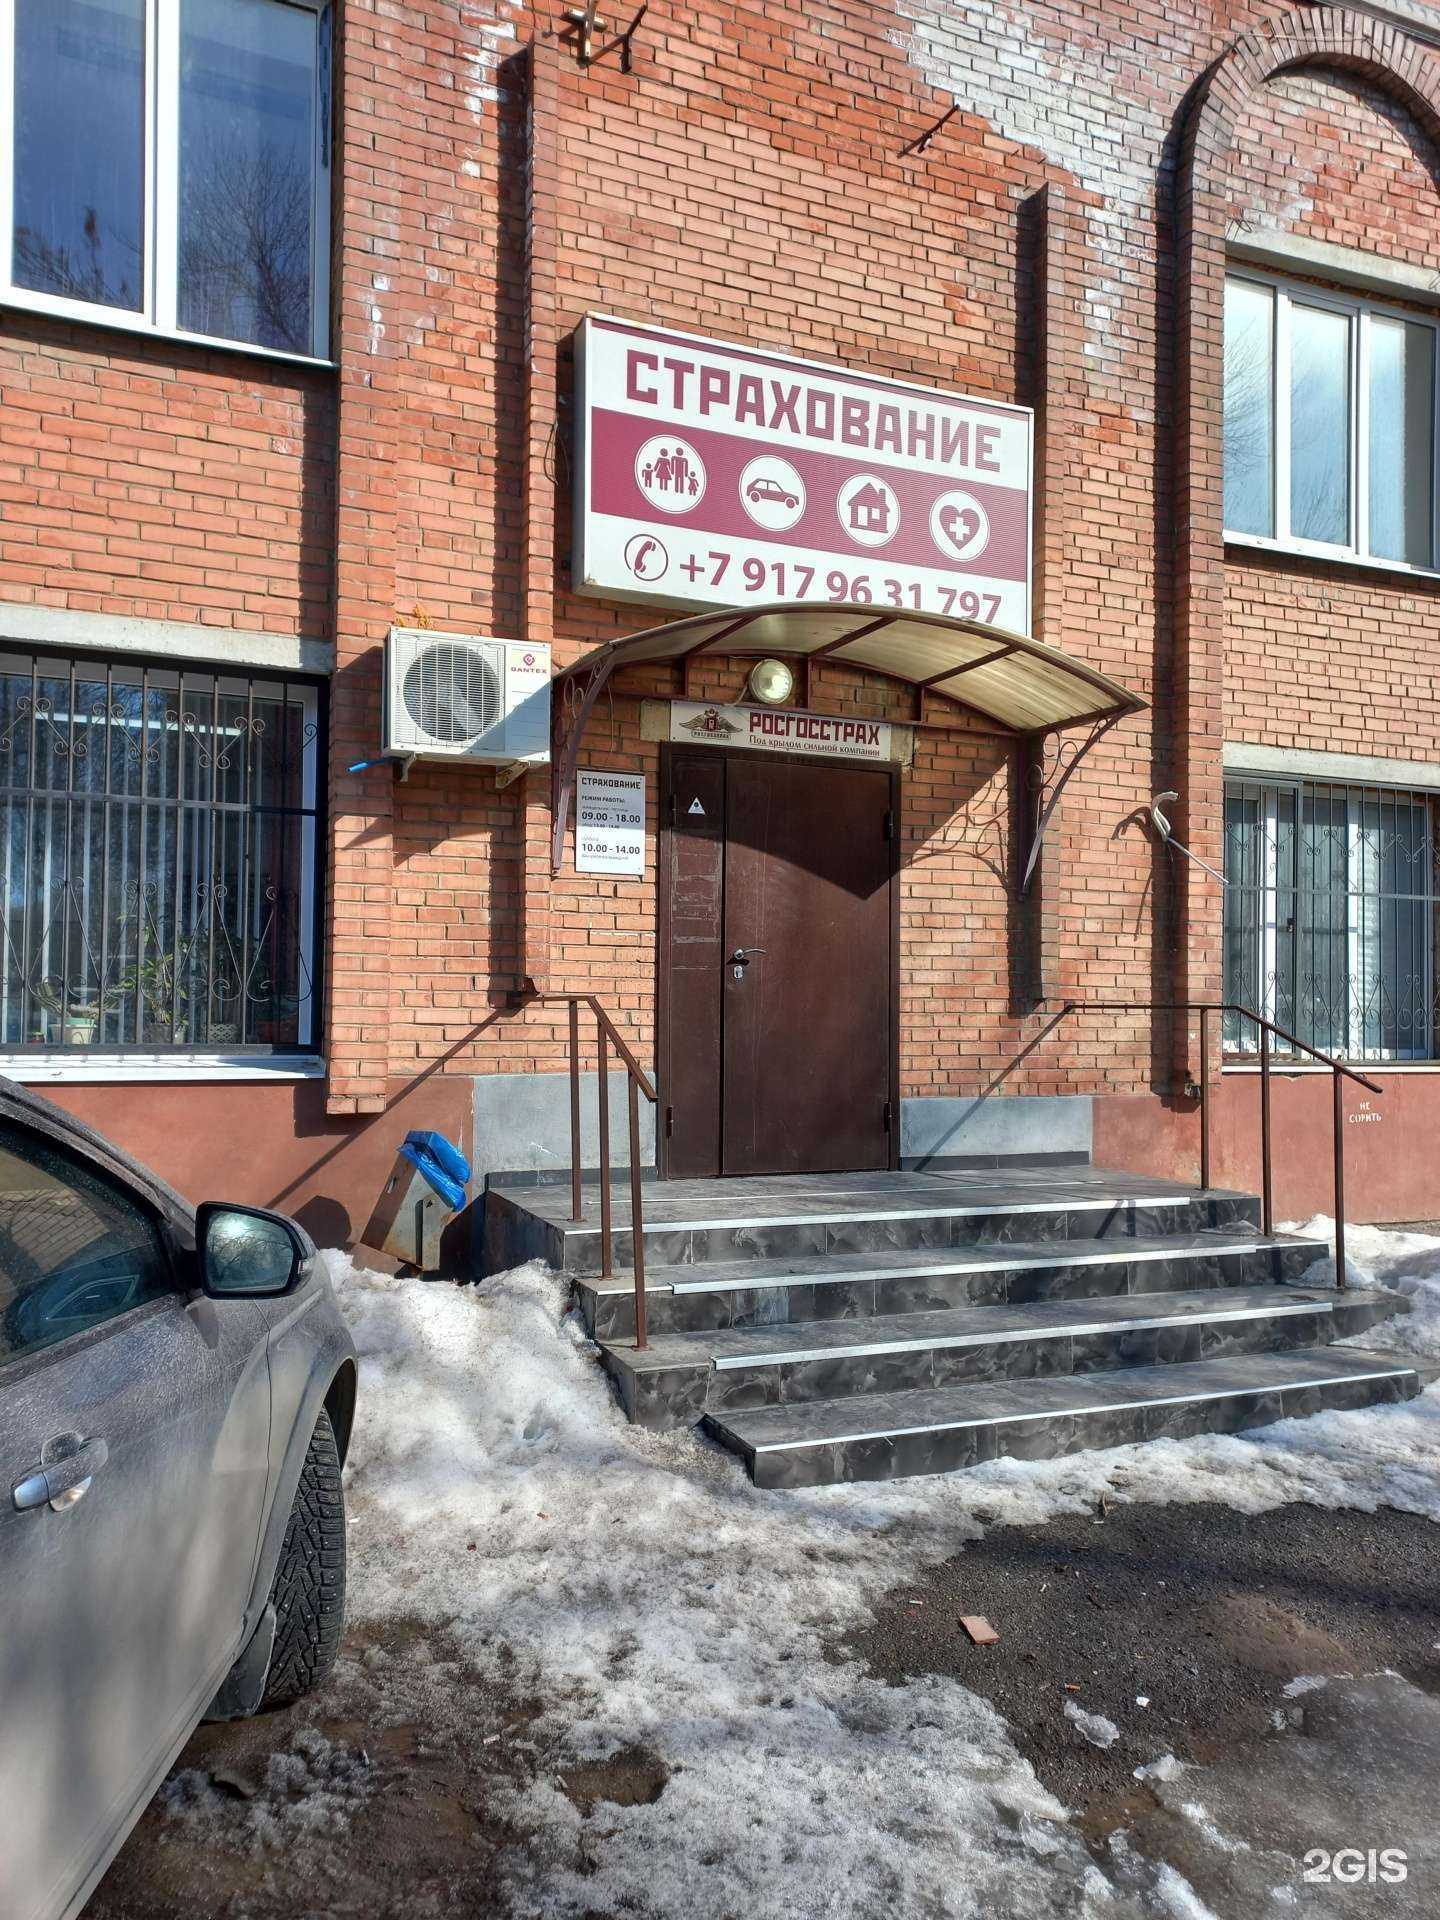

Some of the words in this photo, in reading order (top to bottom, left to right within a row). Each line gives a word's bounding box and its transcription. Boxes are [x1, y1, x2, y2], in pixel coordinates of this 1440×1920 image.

[626, 349, 1002, 473] СТРАХОВАНИЕ
[679, 551, 732, 586] +7
[743, 557, 815, 599] 917
[826, 570, 873, 605] 96
[884, 578, 922, 609] 31
[937, 586, 1002, 625] 797
[749, 711, 880, 746] РОСГОССТРАХ
[749, 734, 767, 746] Под
[768, 739, 801, 750] крылом
[803, 742, 838, 753] сильной
[839, 746, 880, 757] компании
[581, 776, 641, 790] СТРАХОВАНИЕ
[581, 811, 608, 821] 09.00
[615, 814, 641, 823] 18.00
[582, 843, 608, 852] 10.00
[615, 845, 640, 854] 14.00
[1359, 1102, 1370, 1110] НЕ
